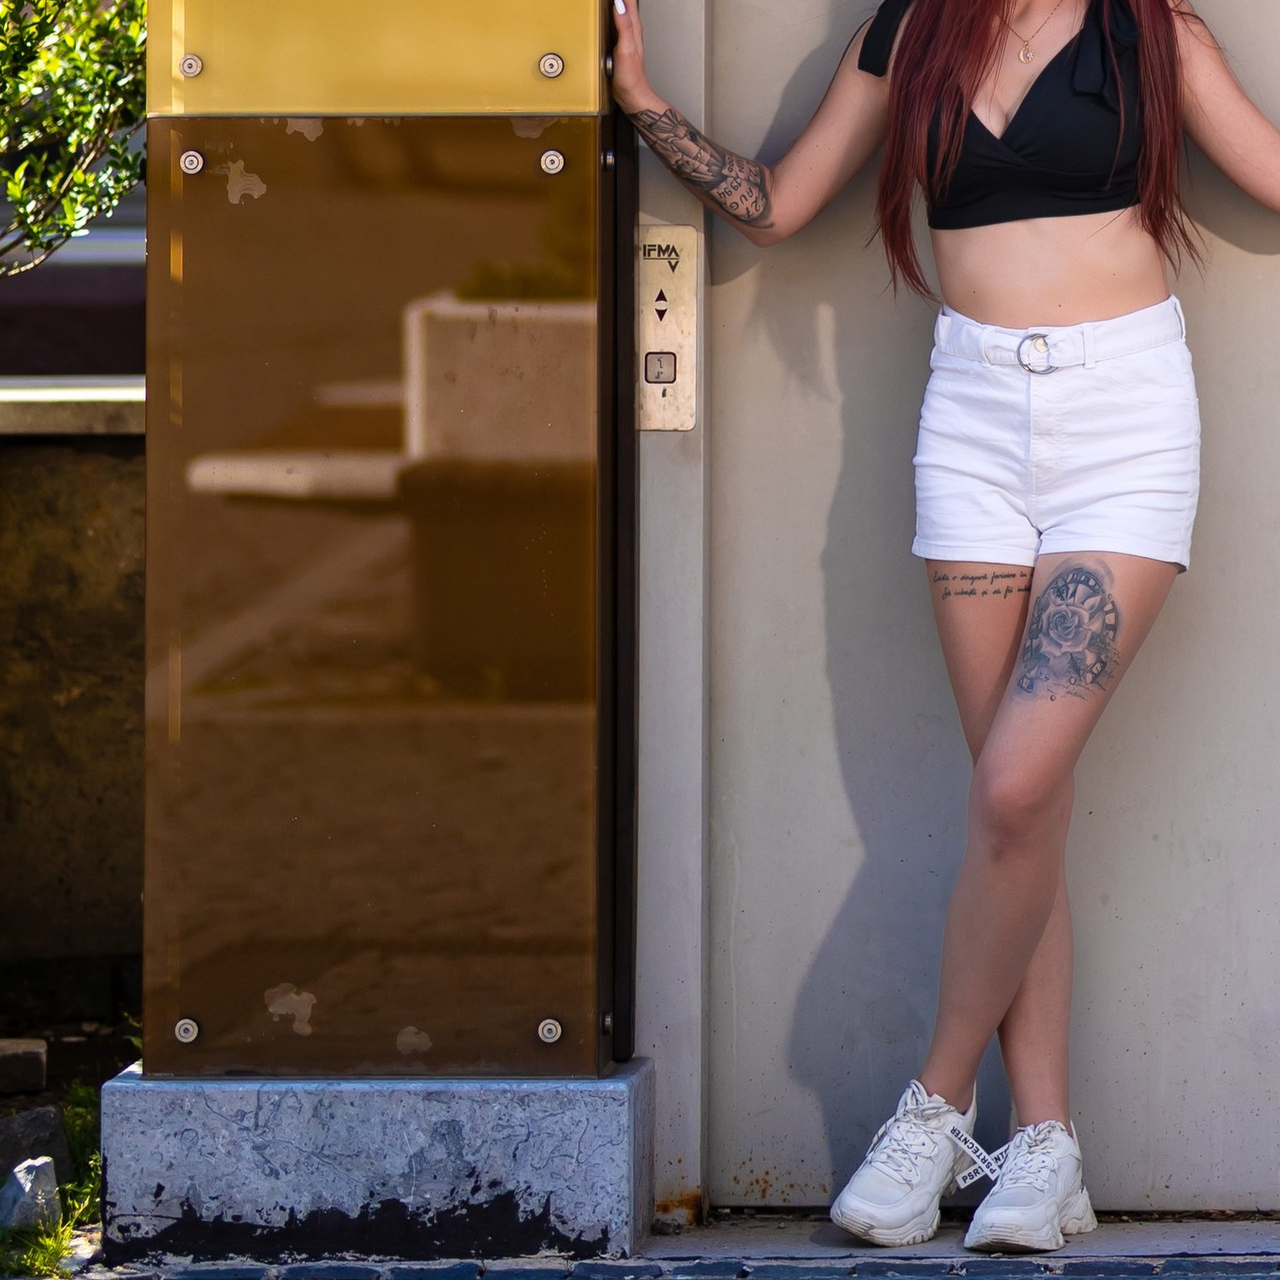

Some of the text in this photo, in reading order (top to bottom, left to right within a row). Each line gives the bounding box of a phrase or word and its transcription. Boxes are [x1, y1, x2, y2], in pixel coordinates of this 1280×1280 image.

[716, 178, 742, 200] 1994
[730, 187, 754, 210] AUG
[643, 244, 679, 258] IFMA
[950, 1125, 997, 1174] PSRTECNTER
